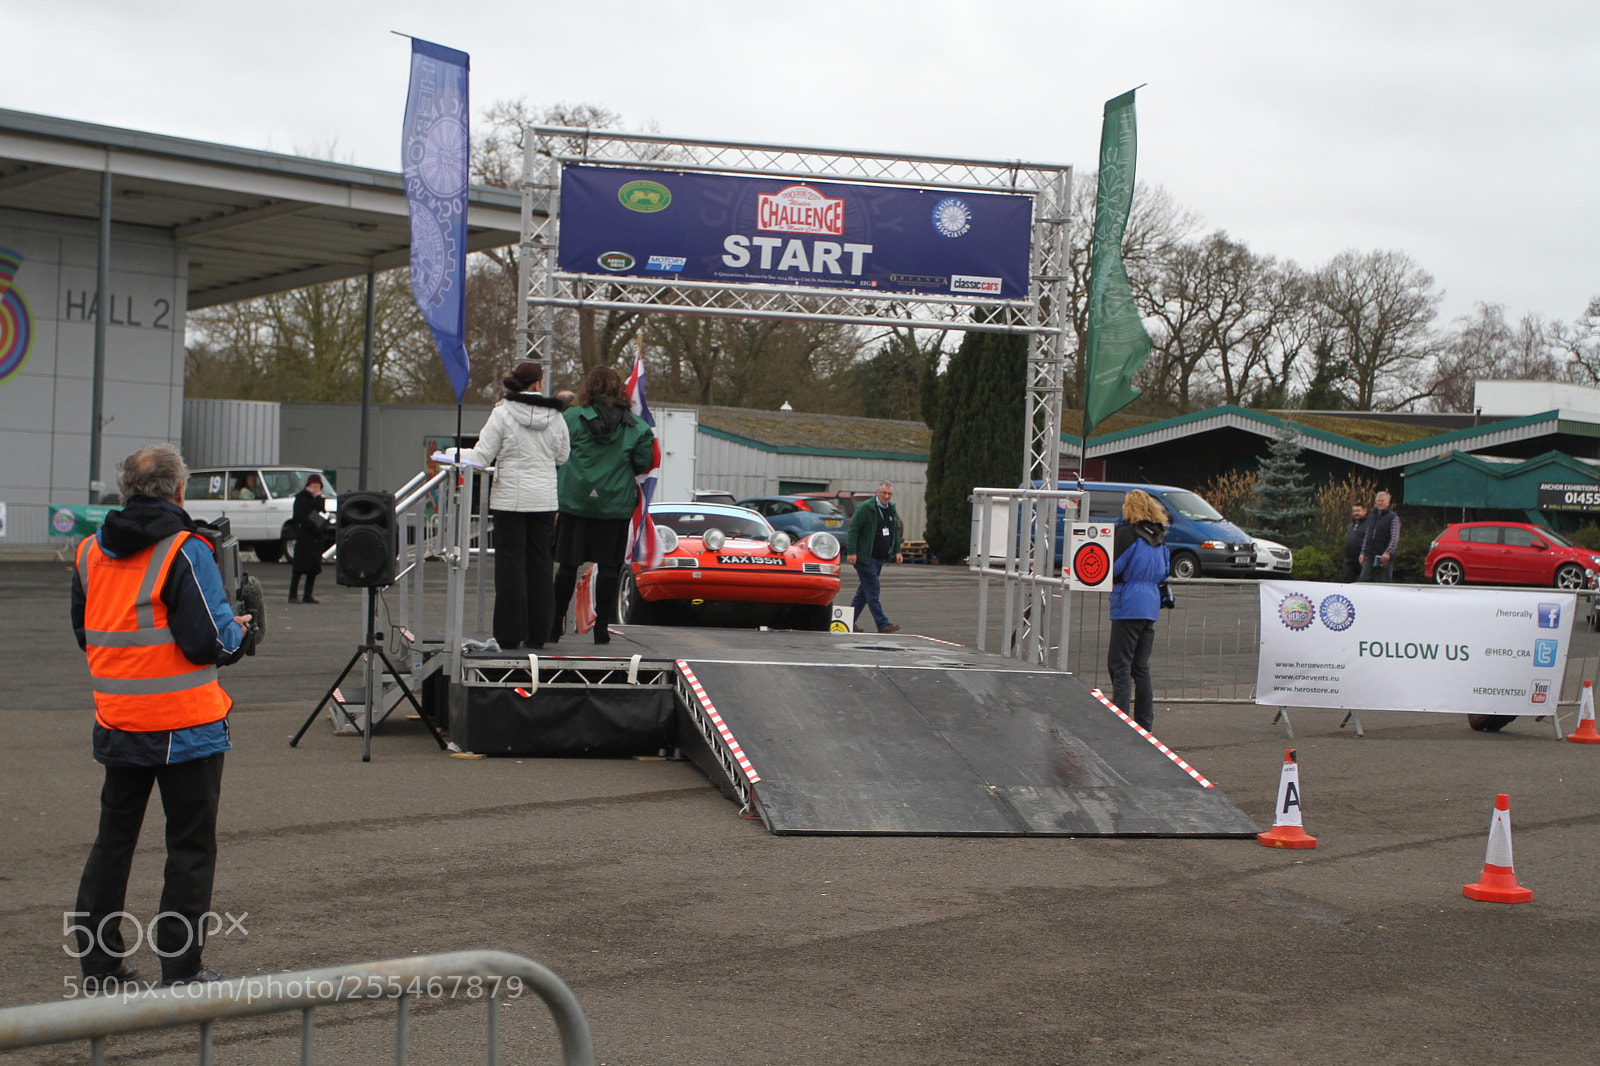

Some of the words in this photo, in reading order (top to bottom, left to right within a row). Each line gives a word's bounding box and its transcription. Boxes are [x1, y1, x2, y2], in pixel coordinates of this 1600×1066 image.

[760, 197, 841, 233] CHALLENGE
[935, 221, 971, 238] ASSOCIATION
[651, 256, 684, 264] MOTORS
[721, 234, 873, 276] START
[153, 298, 170, 329] 2
[208, 475, 221, 494] 19
[1496, 608, 1533, 620] /herorally
[1359, 641, 1439, 659] FOLLOW
[1445, 645, 1470, 661] US
[1484, 647, 1531, 659] @HERO_CRA
[1275, 661, 1346, 670] www.heroevents.eu
[1274, 674, 1340, 682] www.craevents.eu
[1273, 685, 1340, 694] www.herostore.eu
[1472, 687, 1527, 697] HEROEVENTSEU
[1535, 682, 1549, 693] You
[1282, 782, 1301, 814] A
